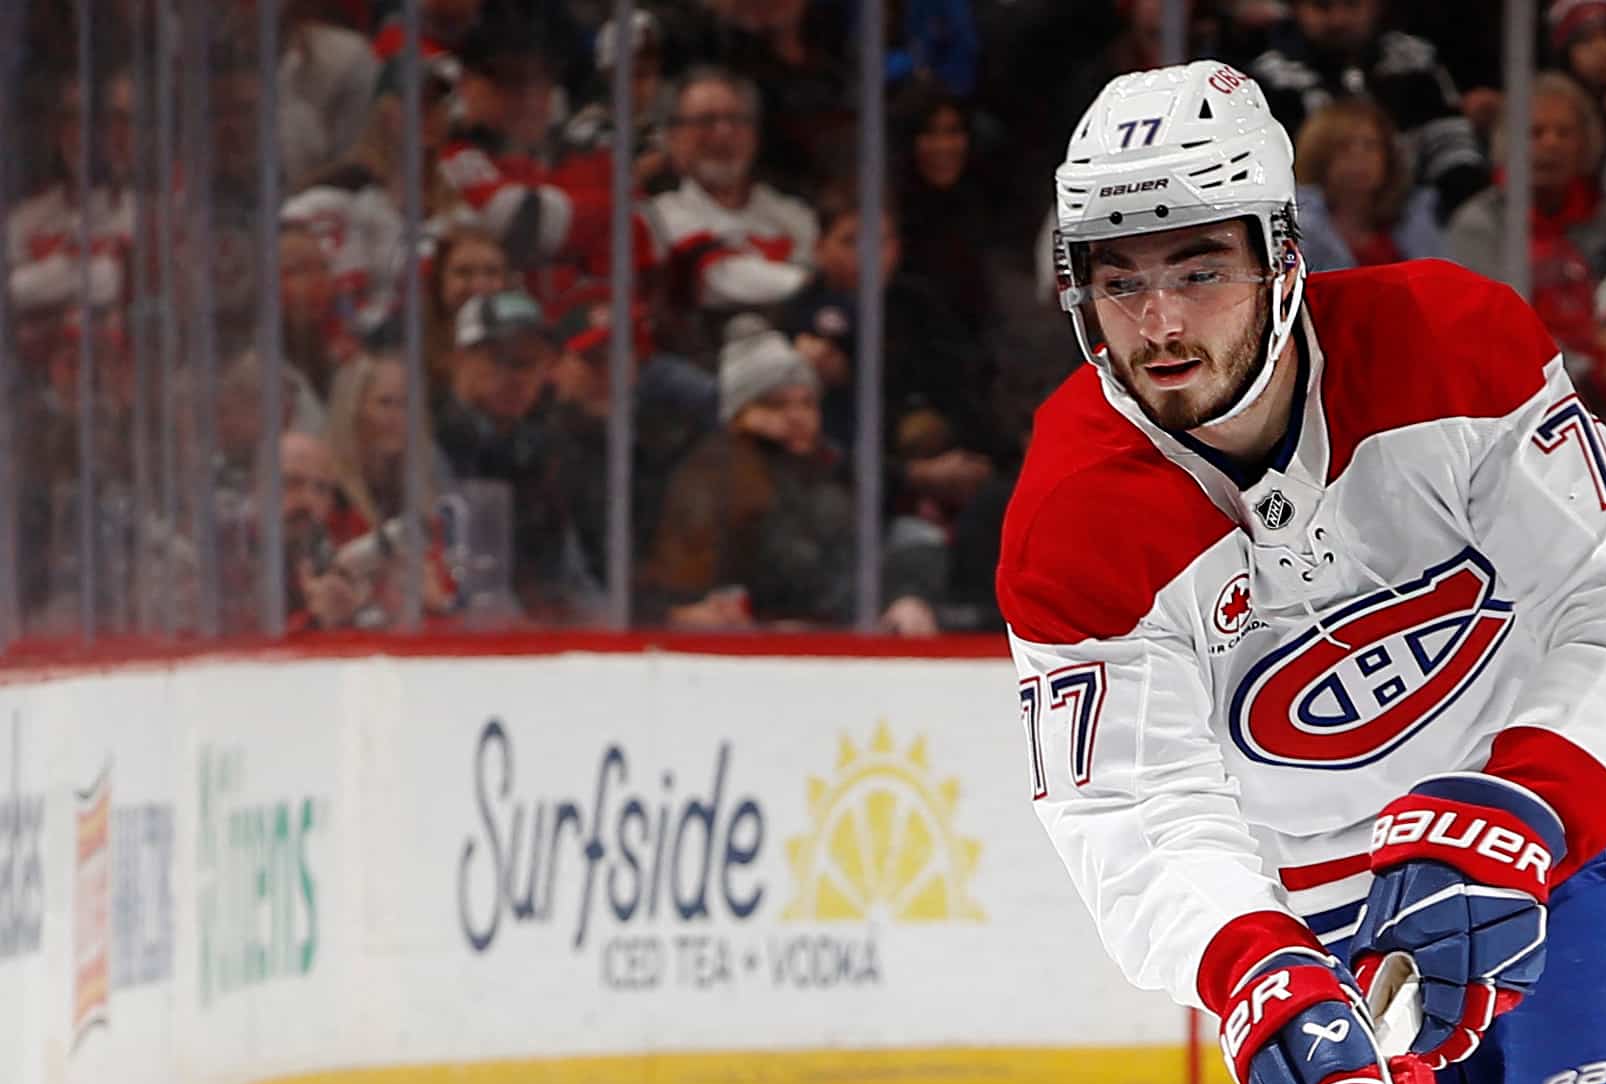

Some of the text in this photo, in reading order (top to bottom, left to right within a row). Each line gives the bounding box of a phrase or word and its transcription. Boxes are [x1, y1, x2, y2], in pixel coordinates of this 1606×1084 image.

[1118, 117, 1164, 149] 77
[457, 714, 767, 954] Surfside
[674, 934, 732, 989] TEA
[767, 932, 882, 989] VODKA
